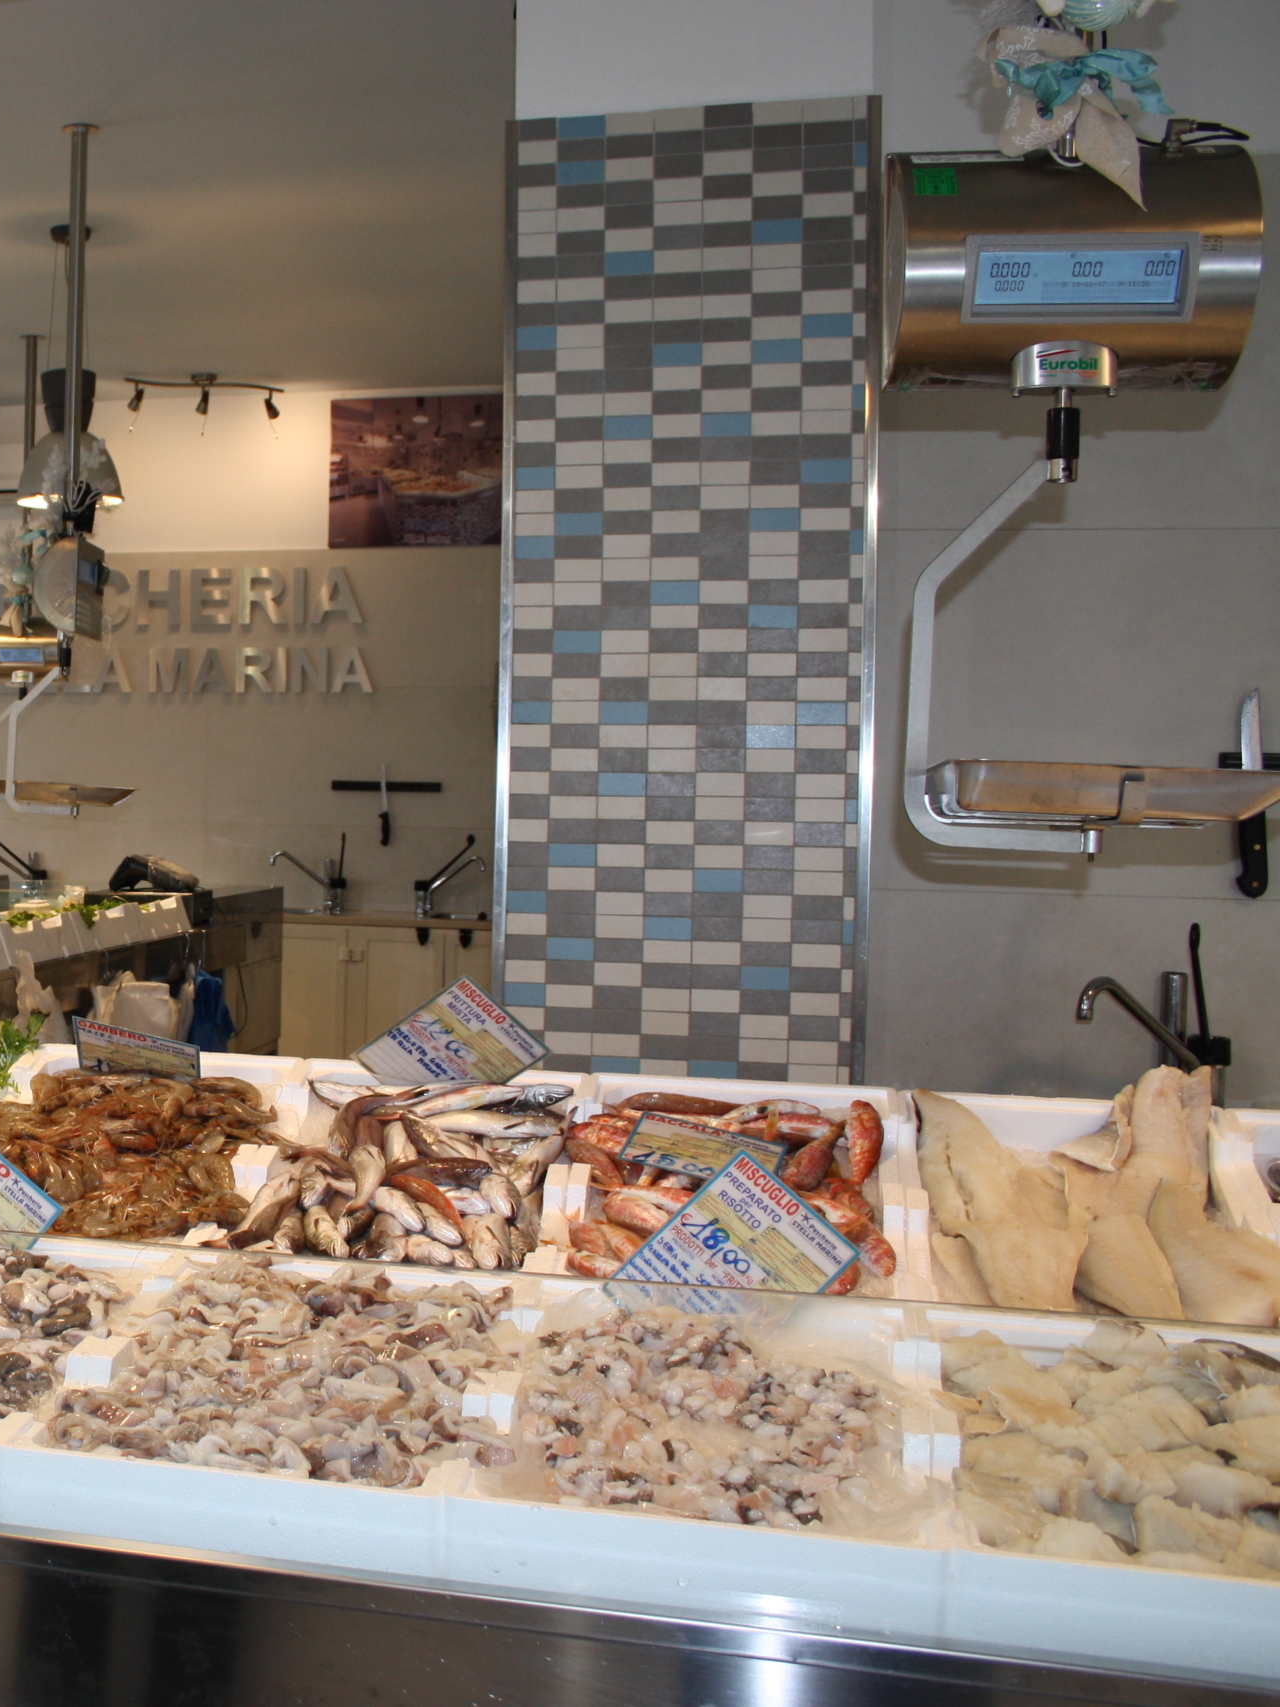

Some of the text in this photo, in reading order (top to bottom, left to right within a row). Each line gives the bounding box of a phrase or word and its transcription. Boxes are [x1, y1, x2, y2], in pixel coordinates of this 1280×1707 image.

[990, 260, 1176, 278] 0.000 0.00 0.00
[1039, 357, 1098, 370] Eurobil
[148, 646, 374, 695] MARINA
[446, 990, 487, 1026] FRITTURA
[446, 1001, 472, 1025] MISTA
[455, 979, 507, 1025] MISCUGLIO
[77, 1020, 148, 1043] GAMBERO
[407, 1021, 432, 1044] PRODOTTI
[18, 1187, 42, 1210] Pescheria
[724, 1171, 782, 1224] PREPARATO
[733, 1155, 801, 1216] MISCUGLIO
[4, 1185, 24, 1205] STELLA
[24, 1202, 47, 1225] MARINA
[718, 1190, 761, 1230] RISOTTO
[739, 1196, 753, 1209] per
[670, 1224, 705, 1257] PRODOTTI
[704, 1258, 719, 1270] per
[672, 1237, 695, 1260] PRODOTTO
[791, 1220, 816, 1242] STELLA
[815, 1241, 842, 1266] MARINA
[809, 1224, 837, 1250] Pescheria
